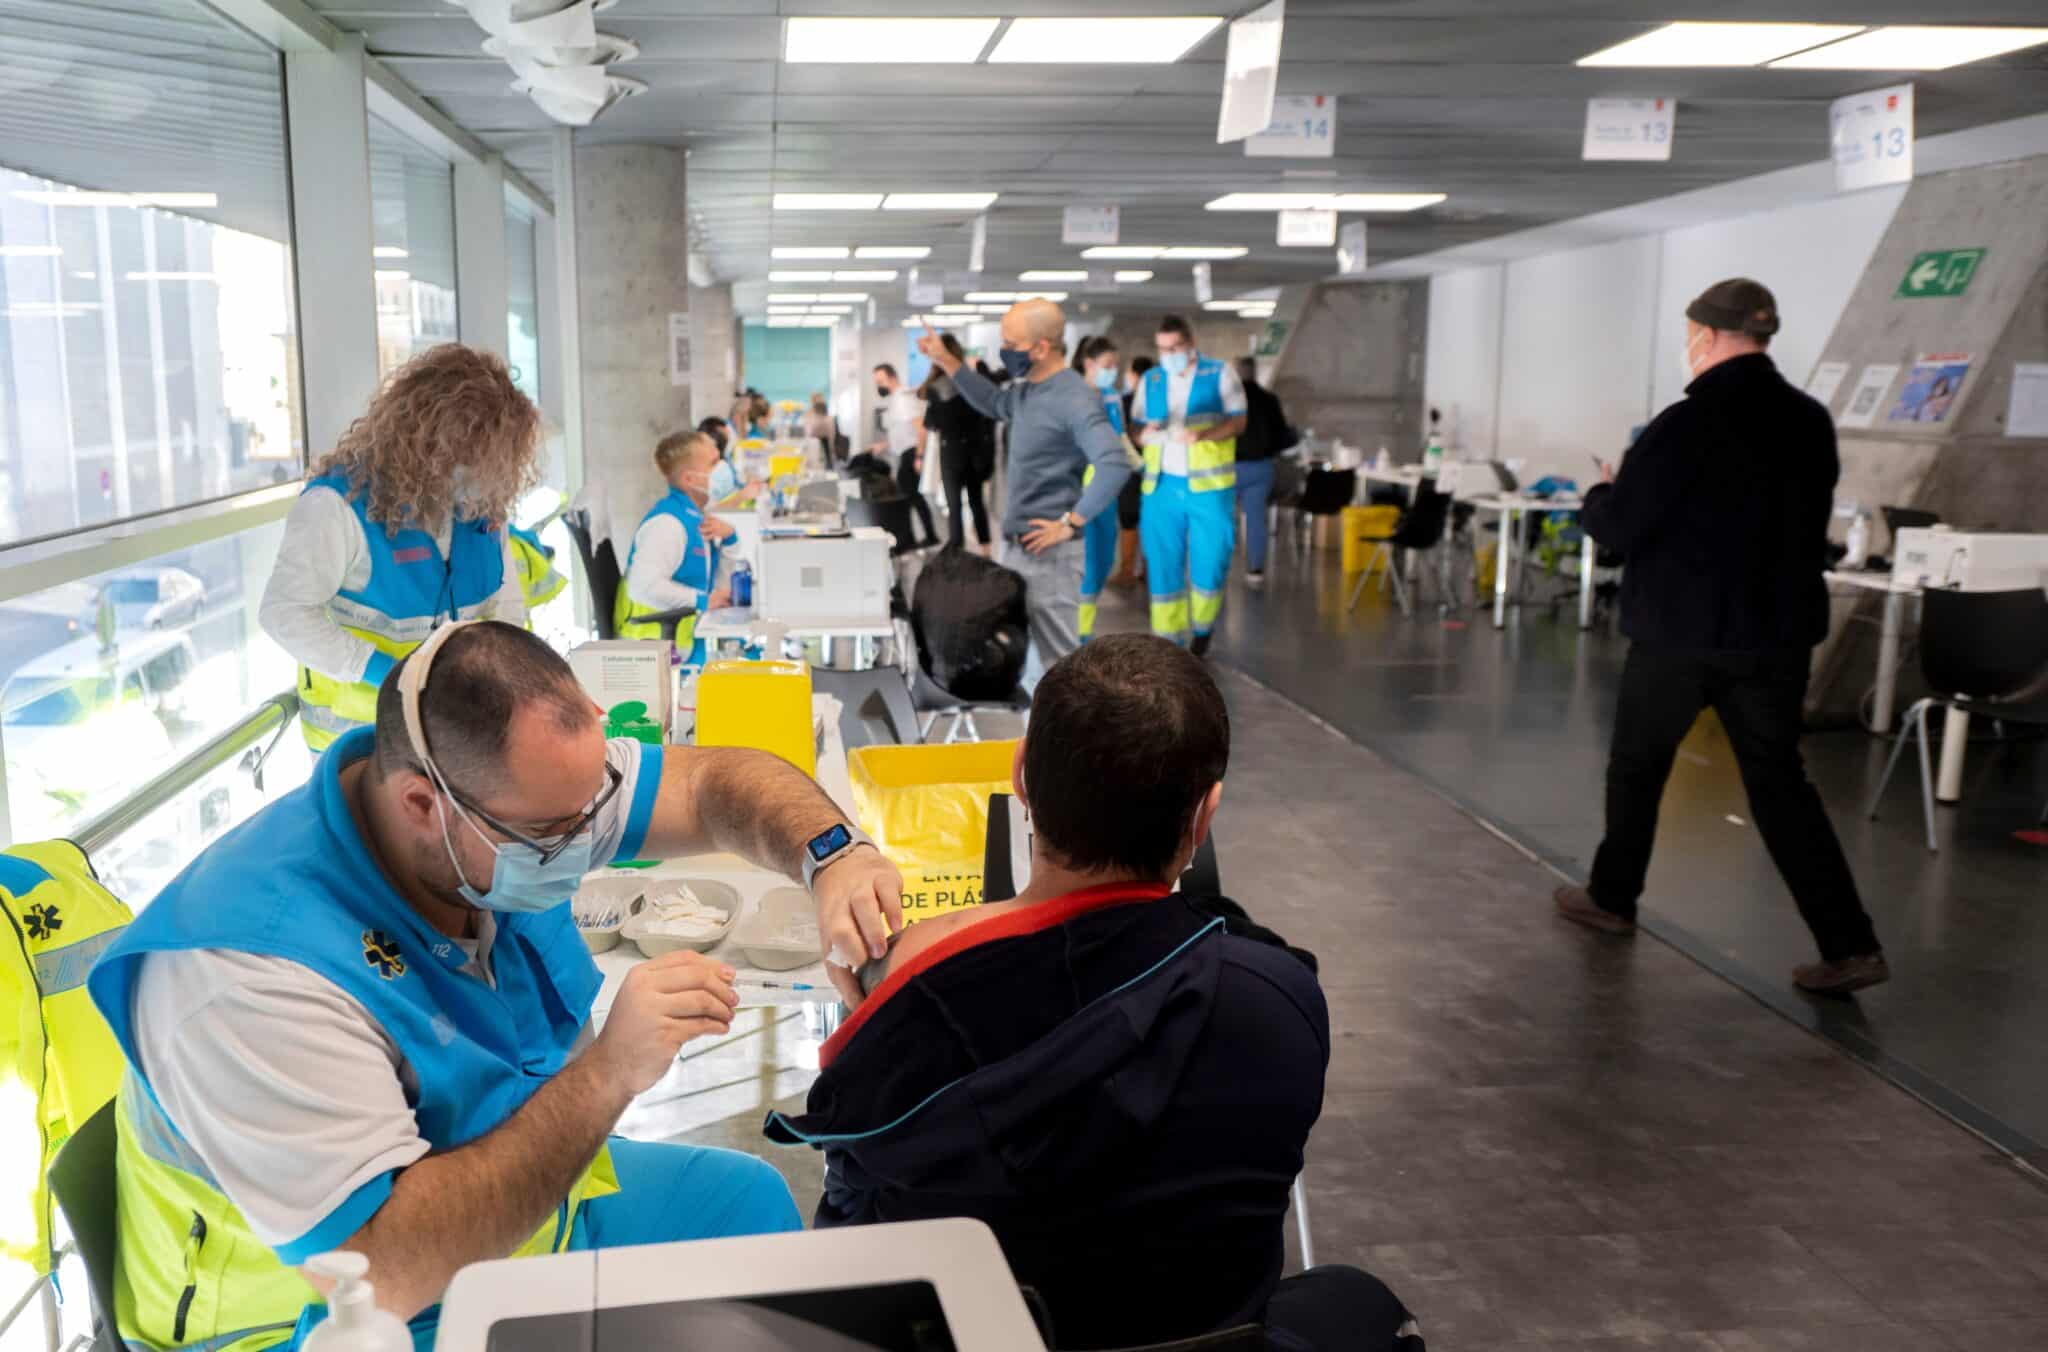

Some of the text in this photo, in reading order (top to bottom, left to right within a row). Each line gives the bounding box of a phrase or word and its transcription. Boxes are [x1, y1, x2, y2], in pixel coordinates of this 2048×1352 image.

[1303, 117, 1329, 140] 14
[1641, 121, 1668, 144] 13
[1872, 128, 1905, 158] 13
[900, 892, 928, 909] DE
